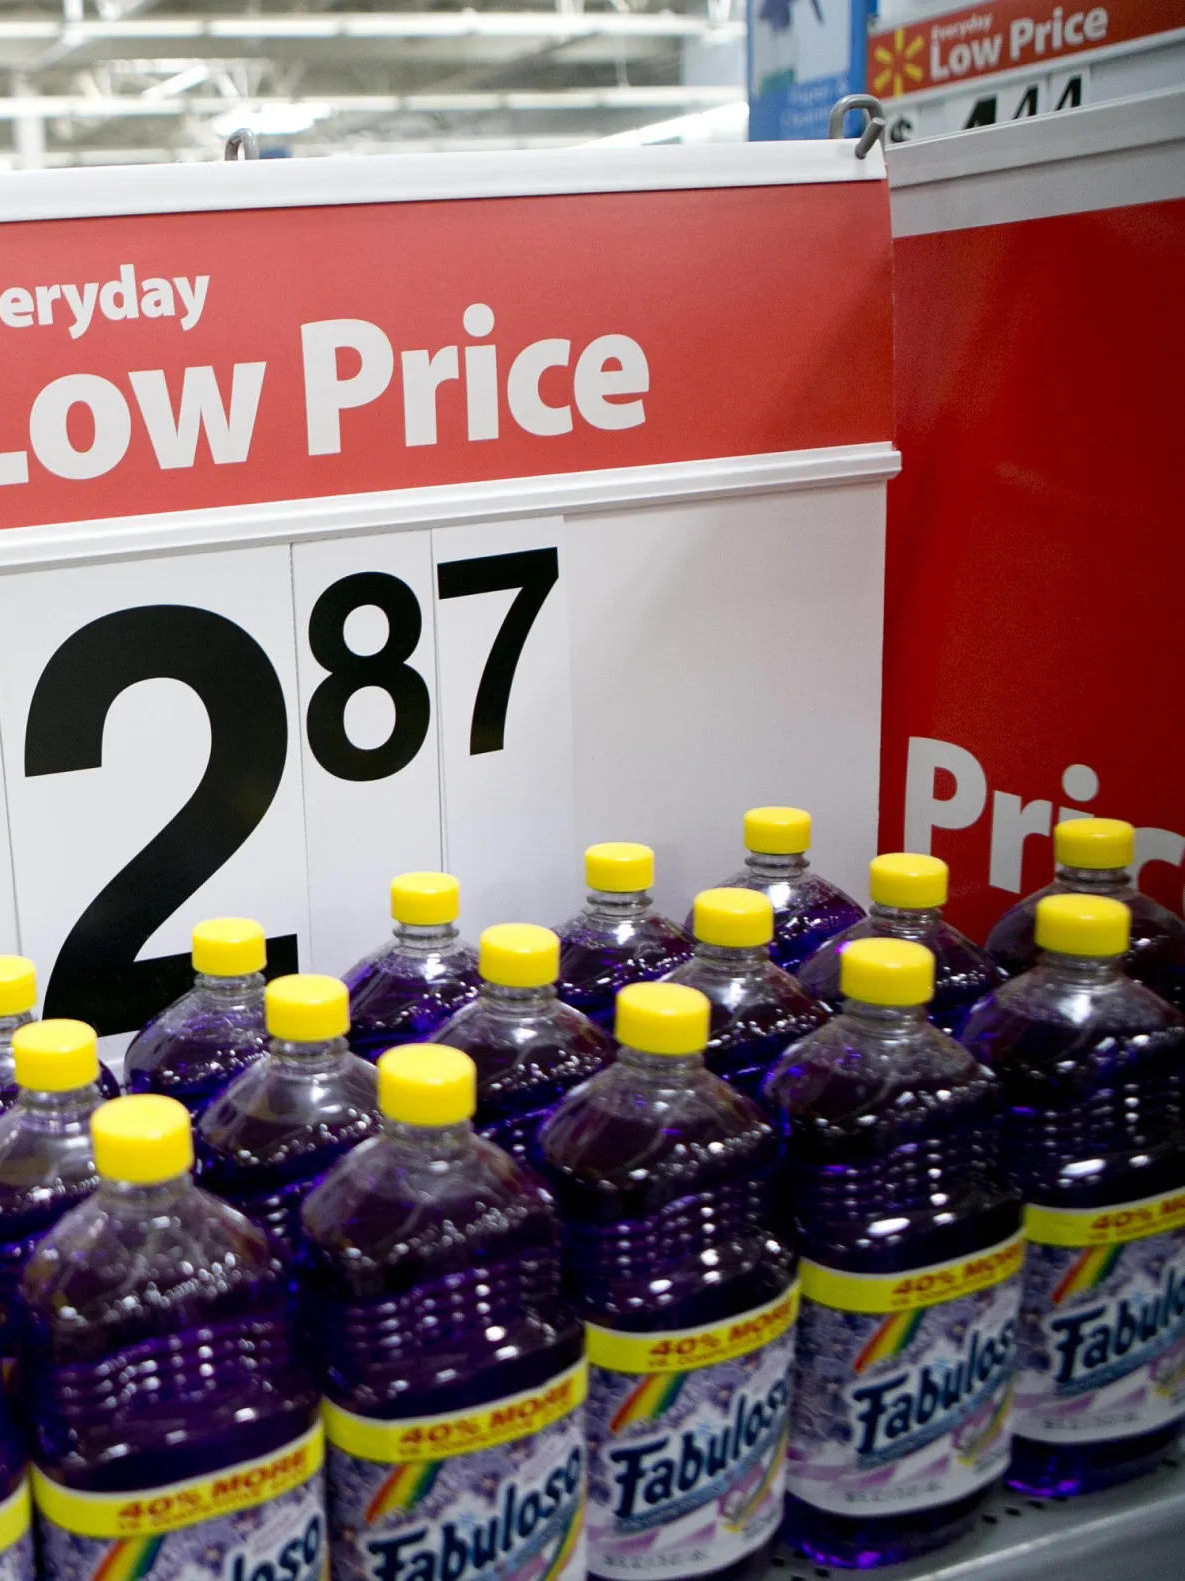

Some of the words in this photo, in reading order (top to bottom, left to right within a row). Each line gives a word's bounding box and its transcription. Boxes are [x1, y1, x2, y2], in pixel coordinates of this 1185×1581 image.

[929, 33, 1003, 82] Low
[1009, 6, 1109, 61] Price
[930, 12, 994, 40] Everyday
[300, 302, 651, 457] Price
[647, 1332, 721, 1356] 40%
[400, 1420, 481, 1444] 40%
[488, 1377, 575, 1429] MORE
[117, 1490, 202, 1520] 40%
[210, 1447, 308, 1498] MORE
[366, 1447, 583, 1581] Fabuloso
